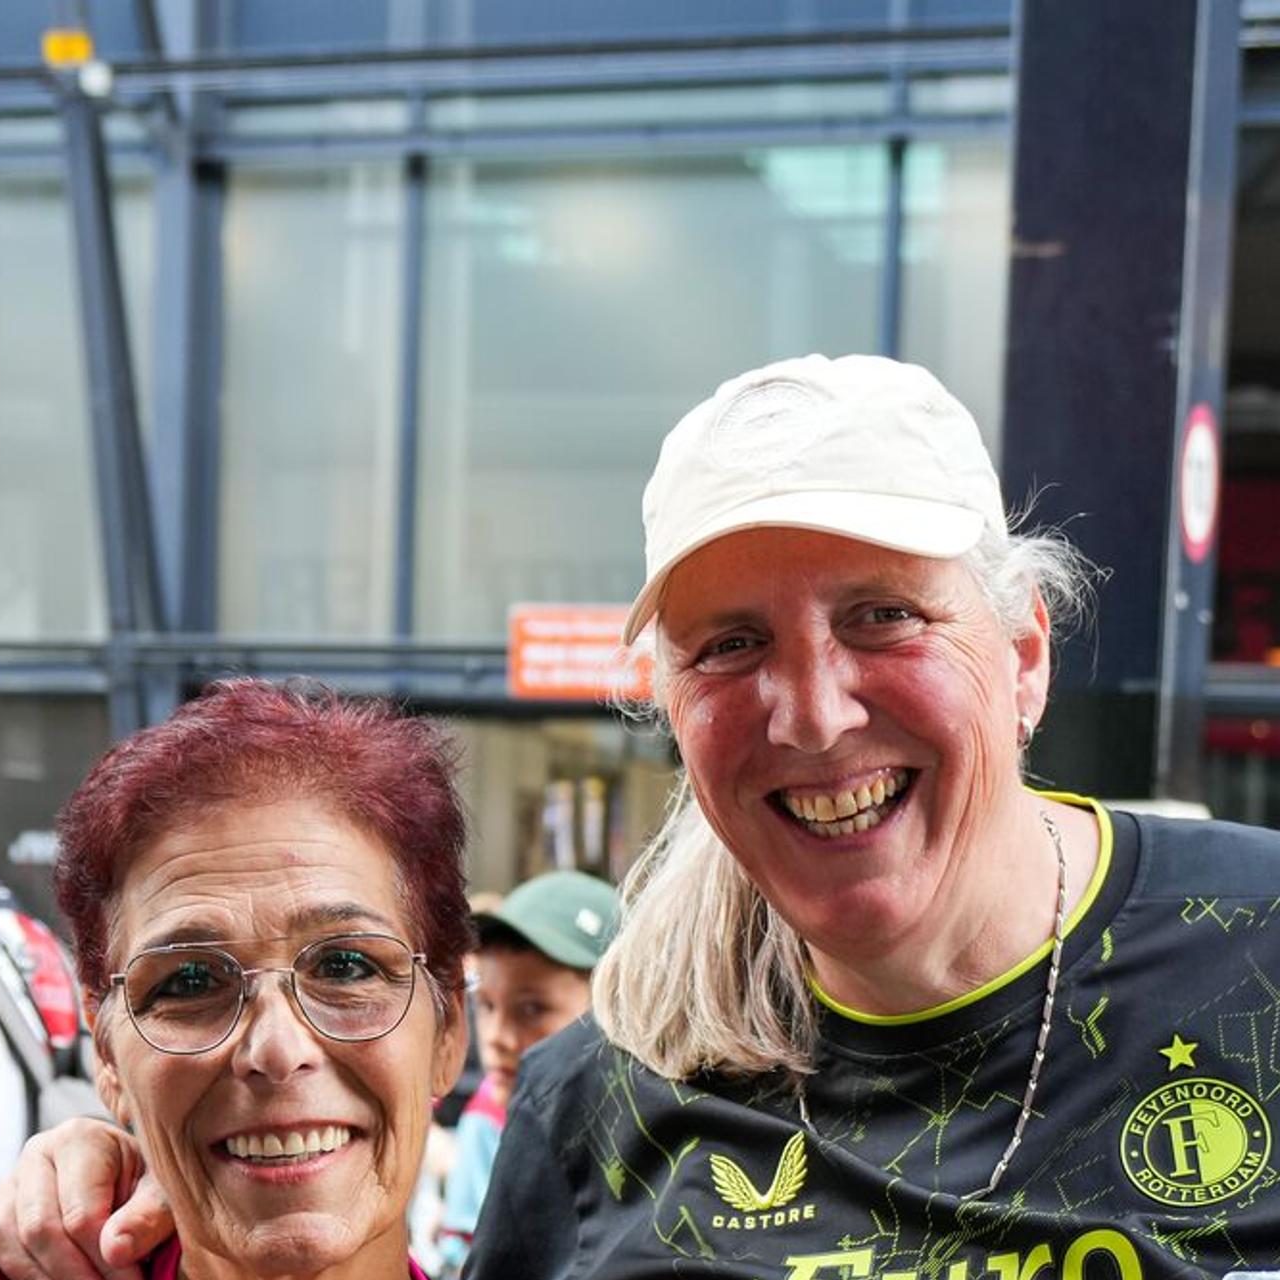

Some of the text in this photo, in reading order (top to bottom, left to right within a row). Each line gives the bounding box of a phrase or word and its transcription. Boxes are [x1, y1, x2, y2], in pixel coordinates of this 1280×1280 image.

[1129, 1083, 1254, 1137] FEYENOORD
[1135, 1152, 1262, 1202] ROTTERDAM
[712, 1204, 816, 1230] CASTORE
